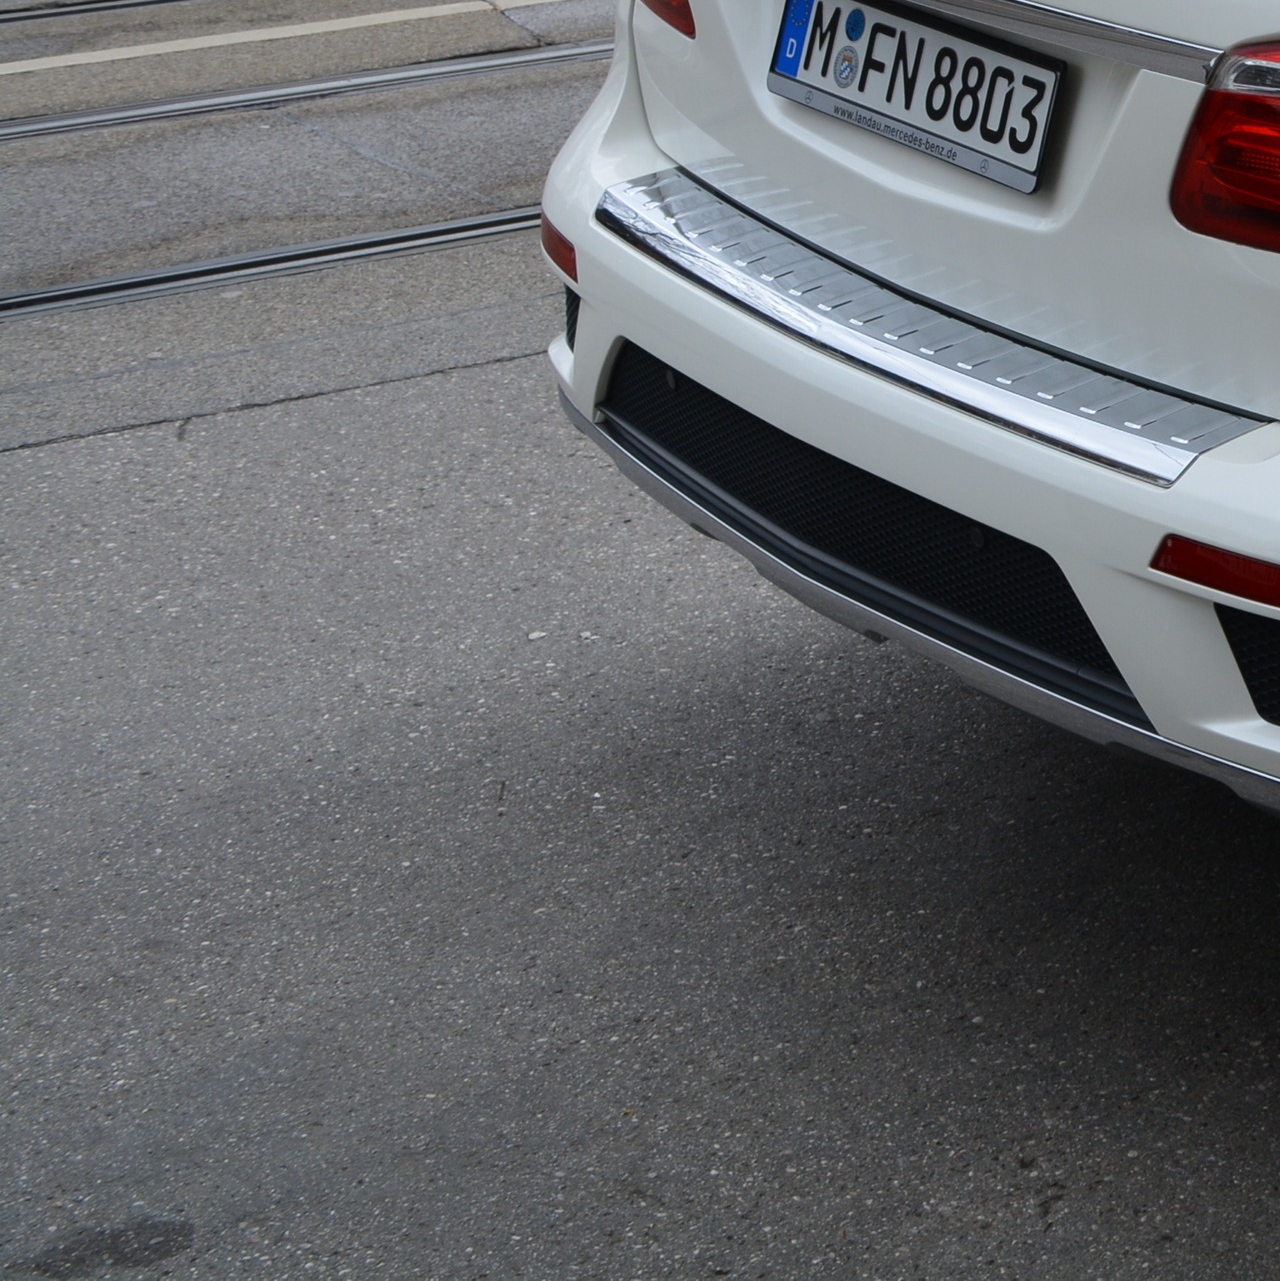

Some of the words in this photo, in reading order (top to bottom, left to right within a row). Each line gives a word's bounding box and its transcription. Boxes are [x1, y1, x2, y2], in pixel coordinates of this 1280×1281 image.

[786, 38, 797, 59] D
[803, 0, 841, 78] M
[857, 21, 926, 111] FN
[925, 46, 1046, 154] 8803
[833, 103, 957, 162] www.landau.mercedes-benz.de
